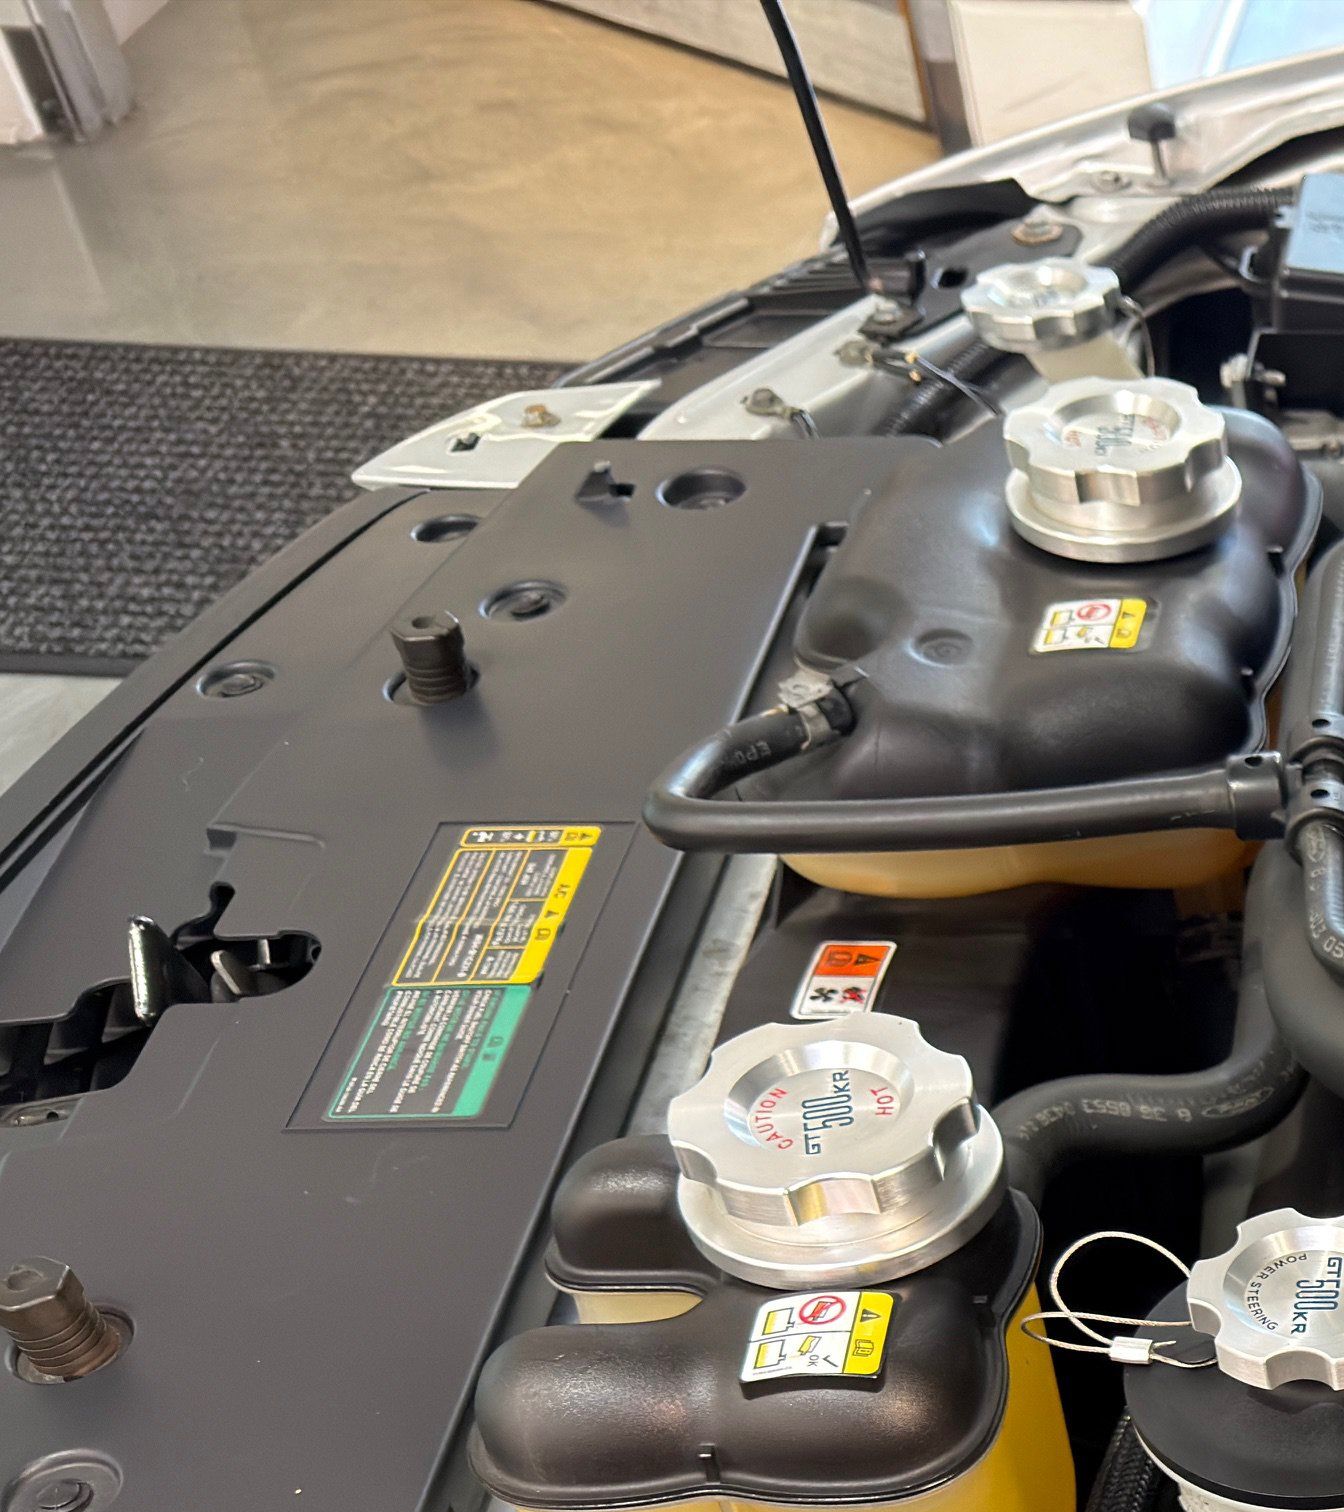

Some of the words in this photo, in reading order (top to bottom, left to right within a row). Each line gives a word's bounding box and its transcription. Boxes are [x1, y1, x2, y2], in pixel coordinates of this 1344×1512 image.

[754, 1087, 794, 1150] CAUTION
[870, 1086, 895, 1116] HOT
[1256, 1252, 1308, 1281] POWER
[1247, 1281, 1279, 1332] STEERING
